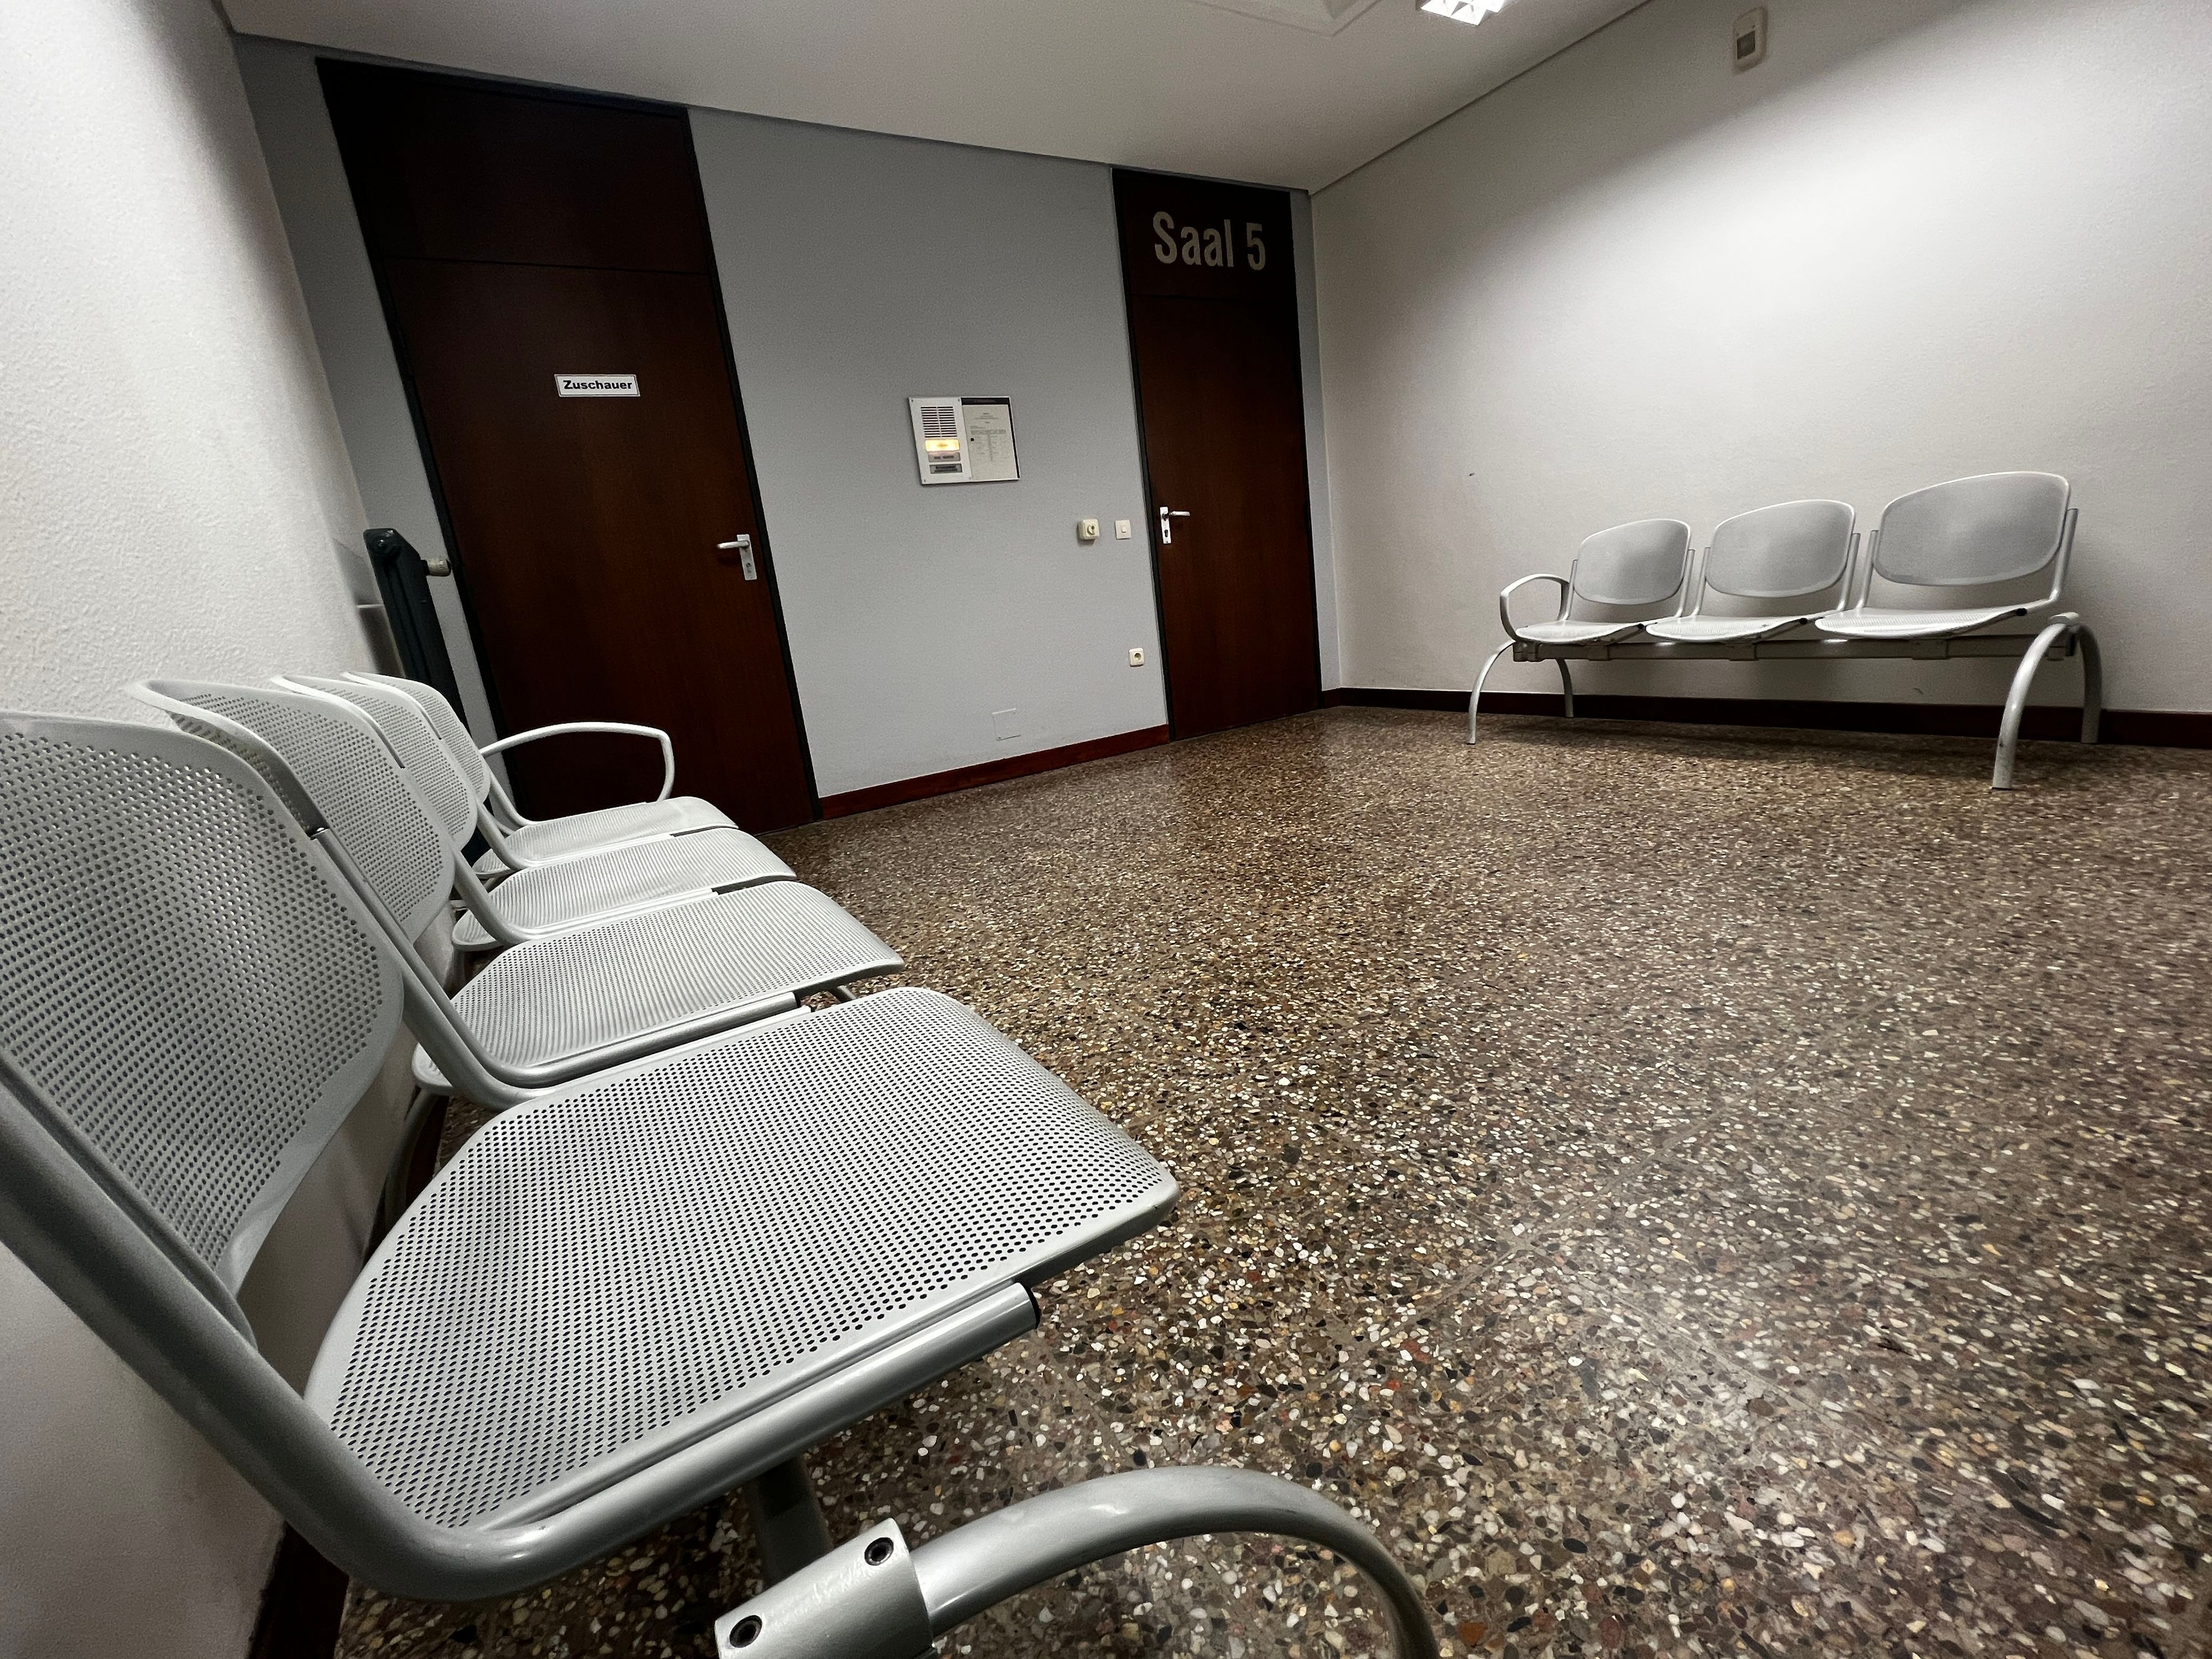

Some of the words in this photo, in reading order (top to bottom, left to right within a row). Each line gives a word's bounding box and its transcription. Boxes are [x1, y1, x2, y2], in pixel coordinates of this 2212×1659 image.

[1153, 211, 1234, 268] Saal
[1246, 222, 1266, 270] 5
[563, 380, 632, 389] Zuschauer
